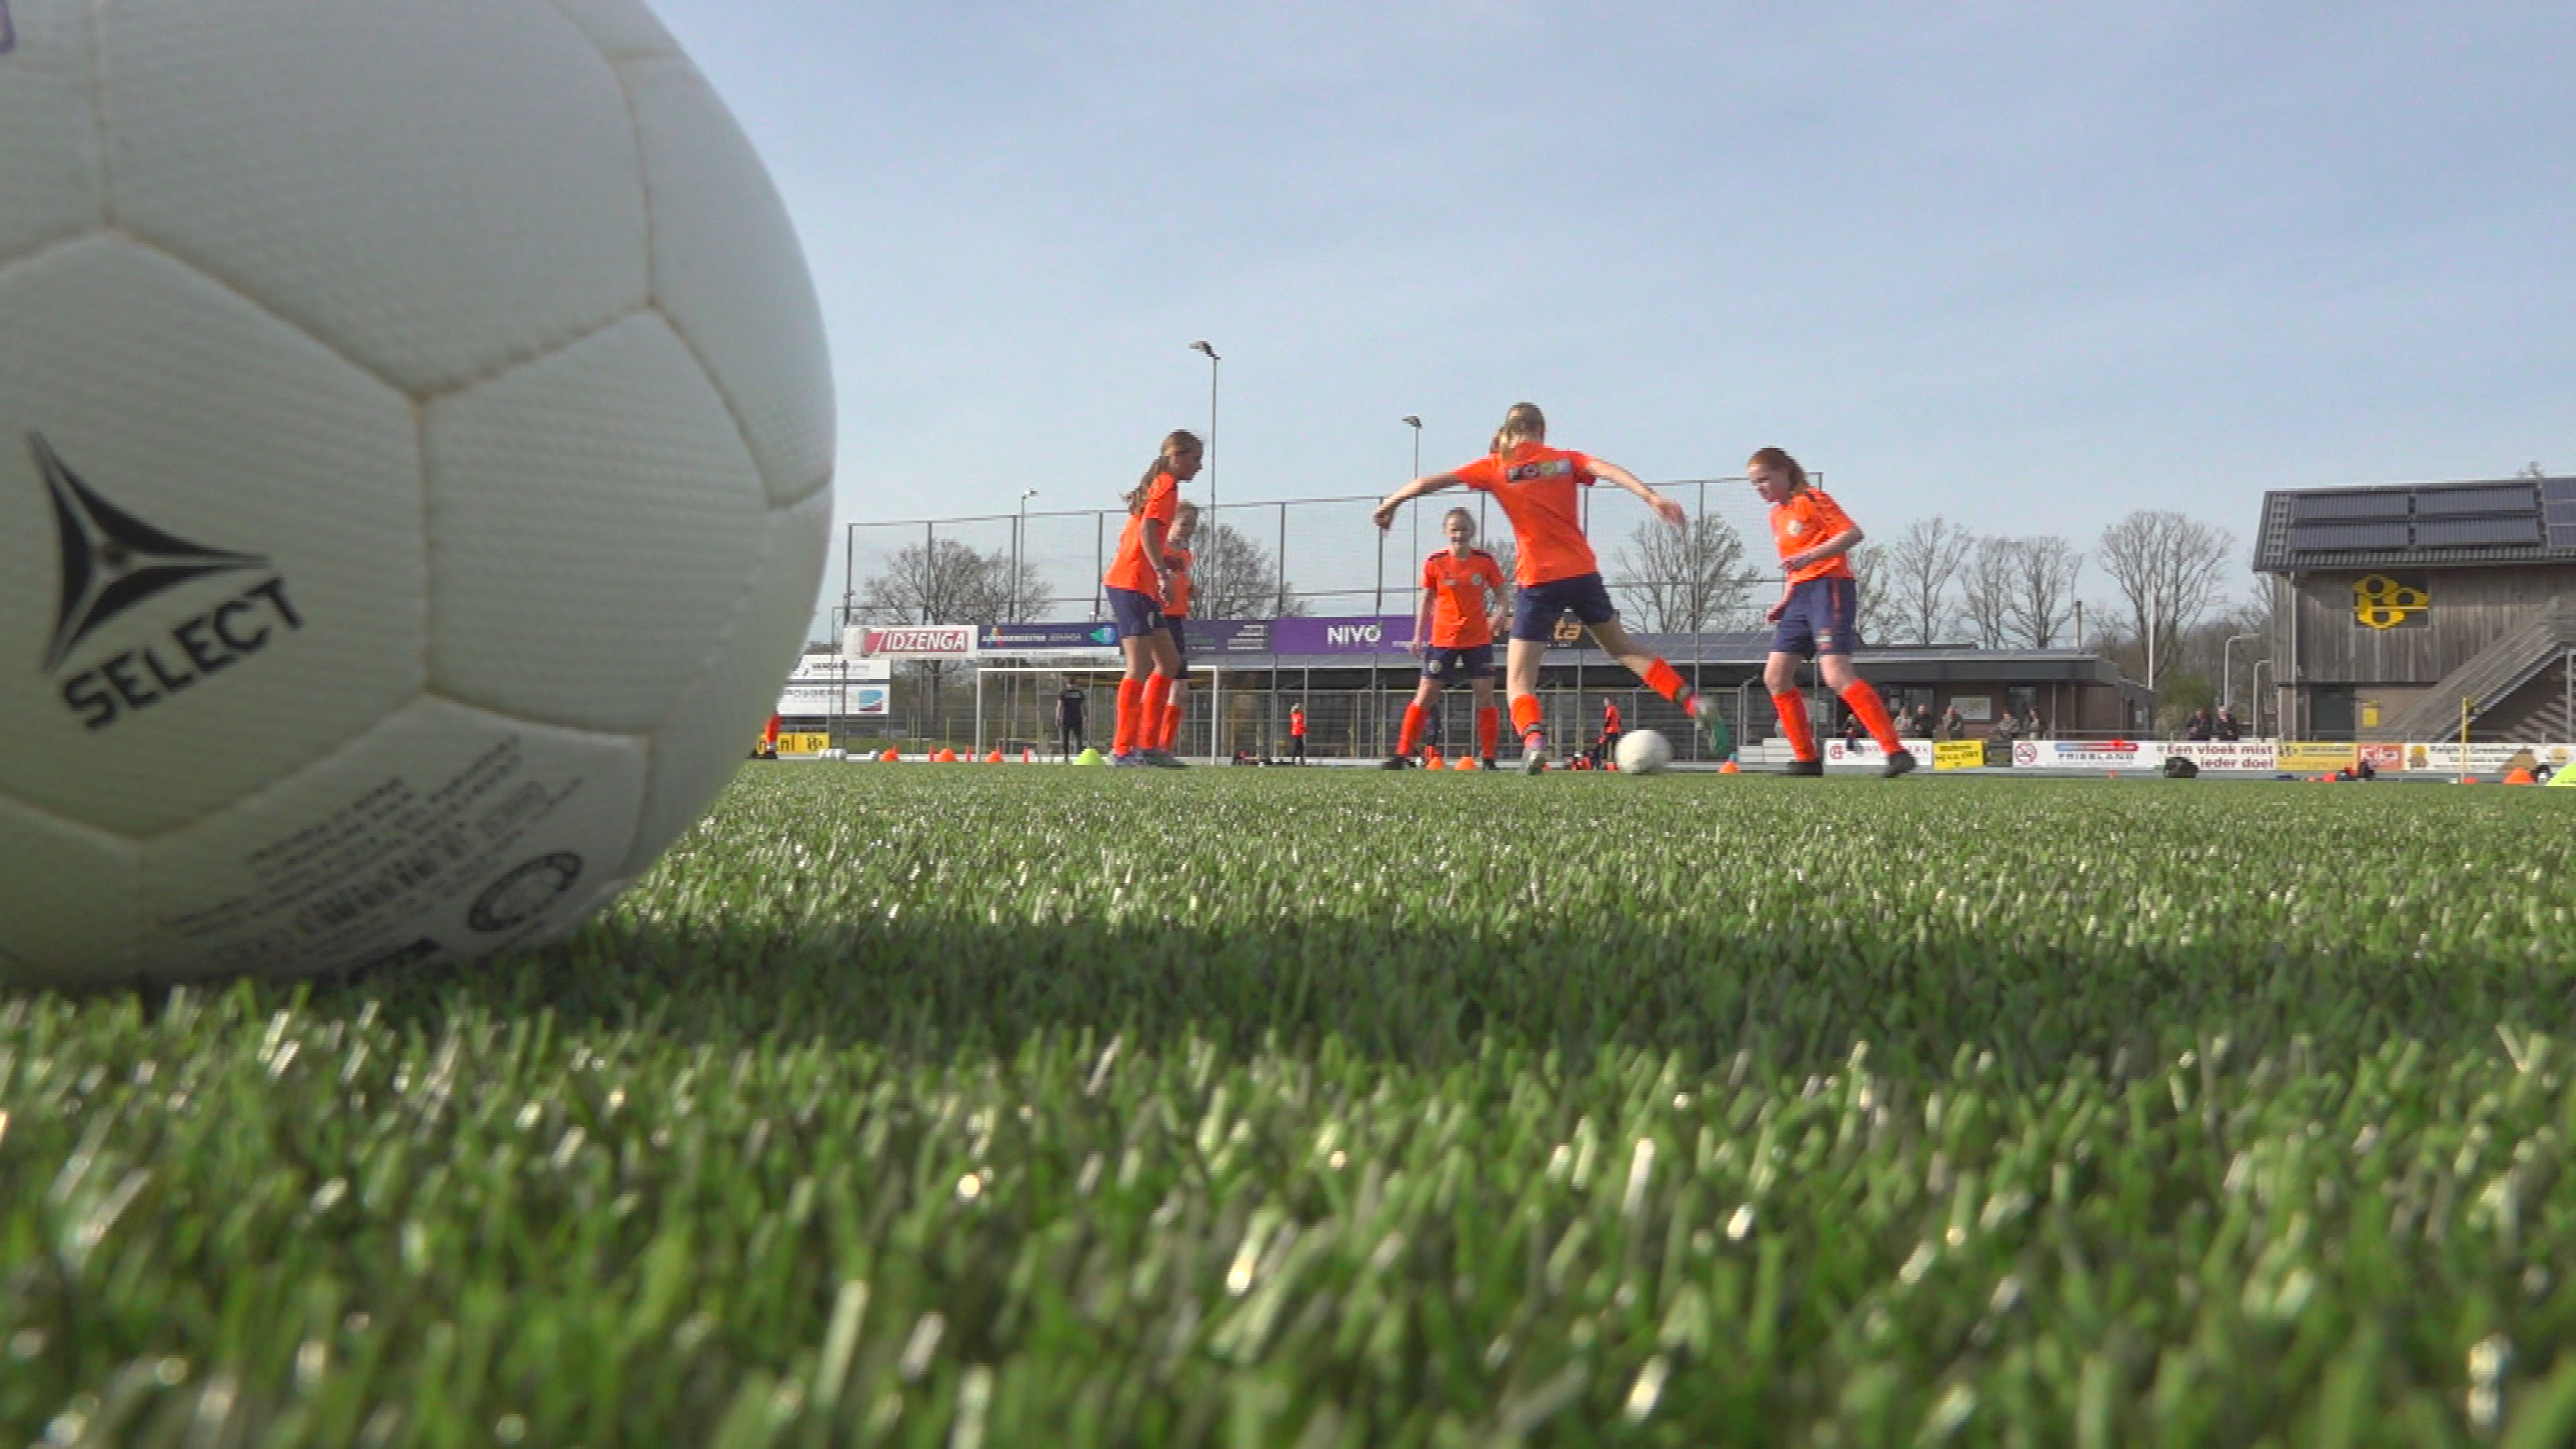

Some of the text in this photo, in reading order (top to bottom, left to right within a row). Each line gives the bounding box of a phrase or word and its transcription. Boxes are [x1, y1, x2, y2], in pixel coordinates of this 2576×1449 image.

[1328, 623, 1382, 645] NIVO
[62, 576, 305, 732] SELECT
[2167, 745, 2273, 755] Een vloek mist
[2200, 757, 2273, 768] ieder doel
